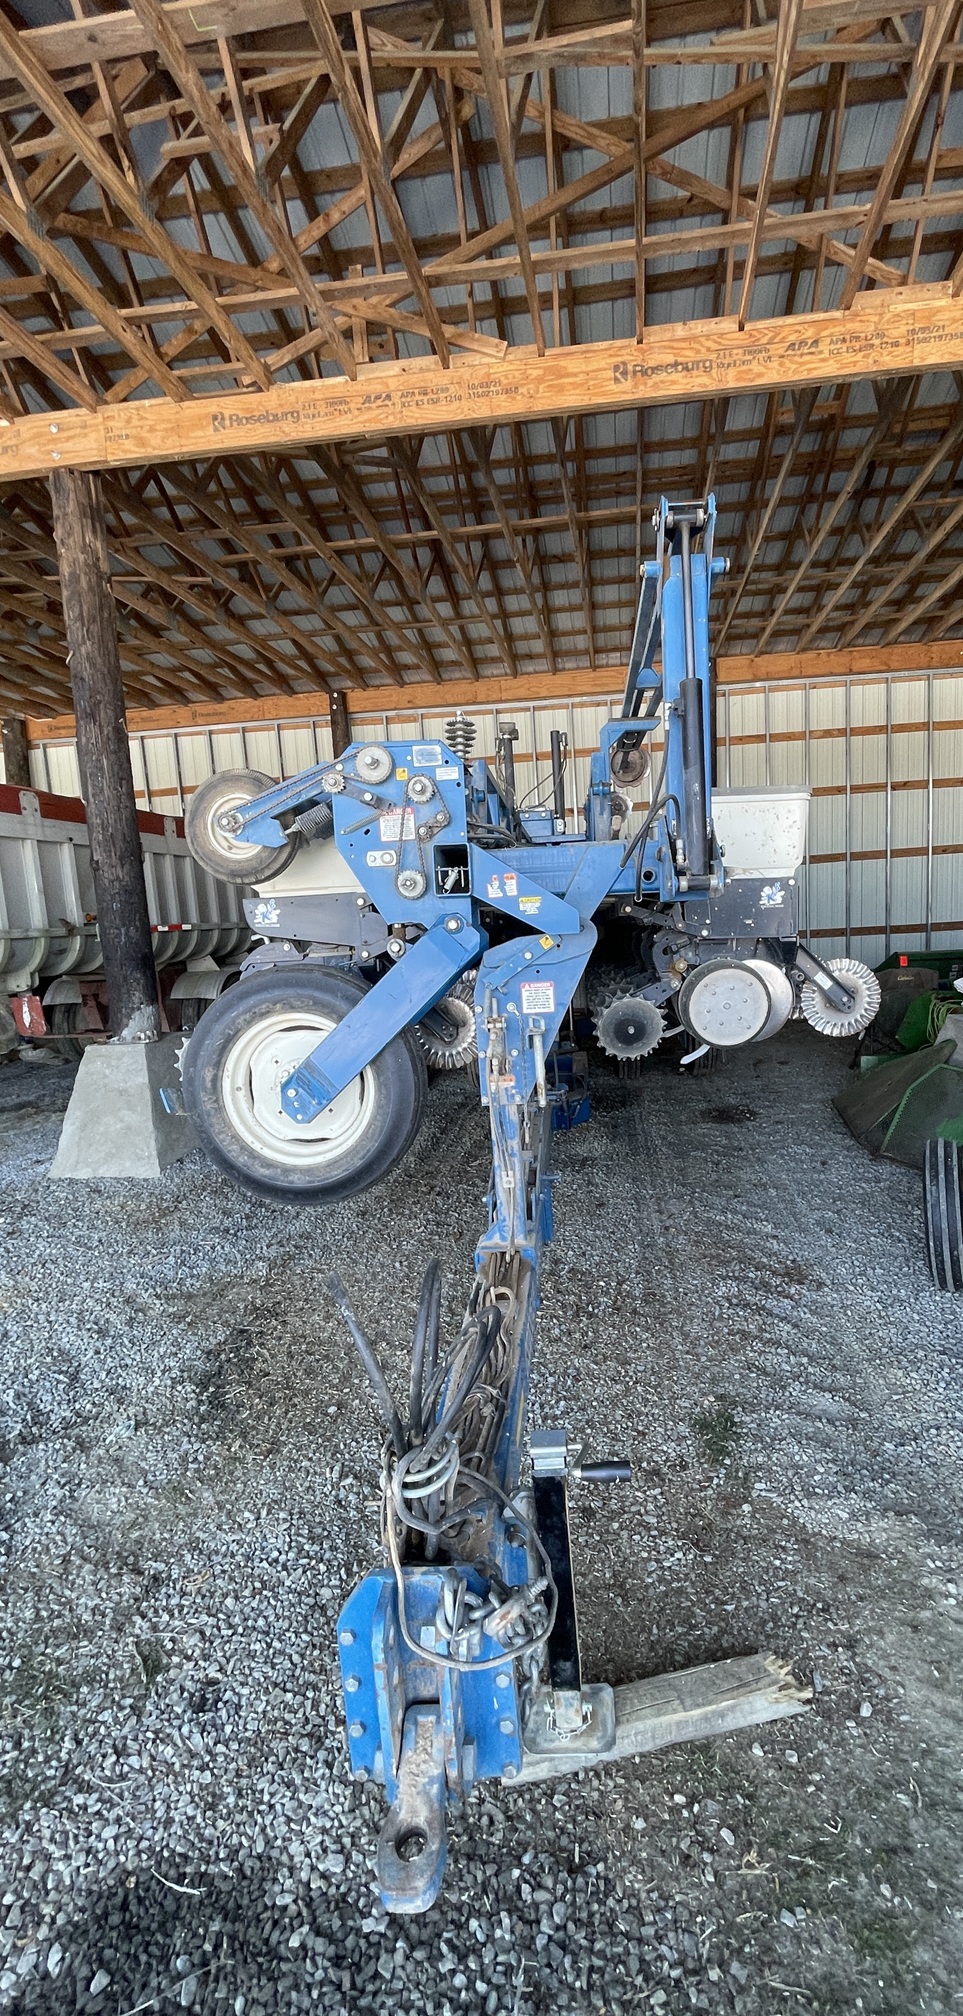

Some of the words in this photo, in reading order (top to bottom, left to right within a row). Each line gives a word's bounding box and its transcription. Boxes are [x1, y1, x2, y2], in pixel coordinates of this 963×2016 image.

[829, 336, 847, 345] APA
[784, 339, 819, 353] APA
[829, 347, 843, 356] ICC
[632, 359, 713, 378] Roseburg
[361, 393, 392, 405] APA
[400, 391, 416, 399] APA
[401, 400, 413, 409] ICC
[228, 410, 300, 428] Roseburg
